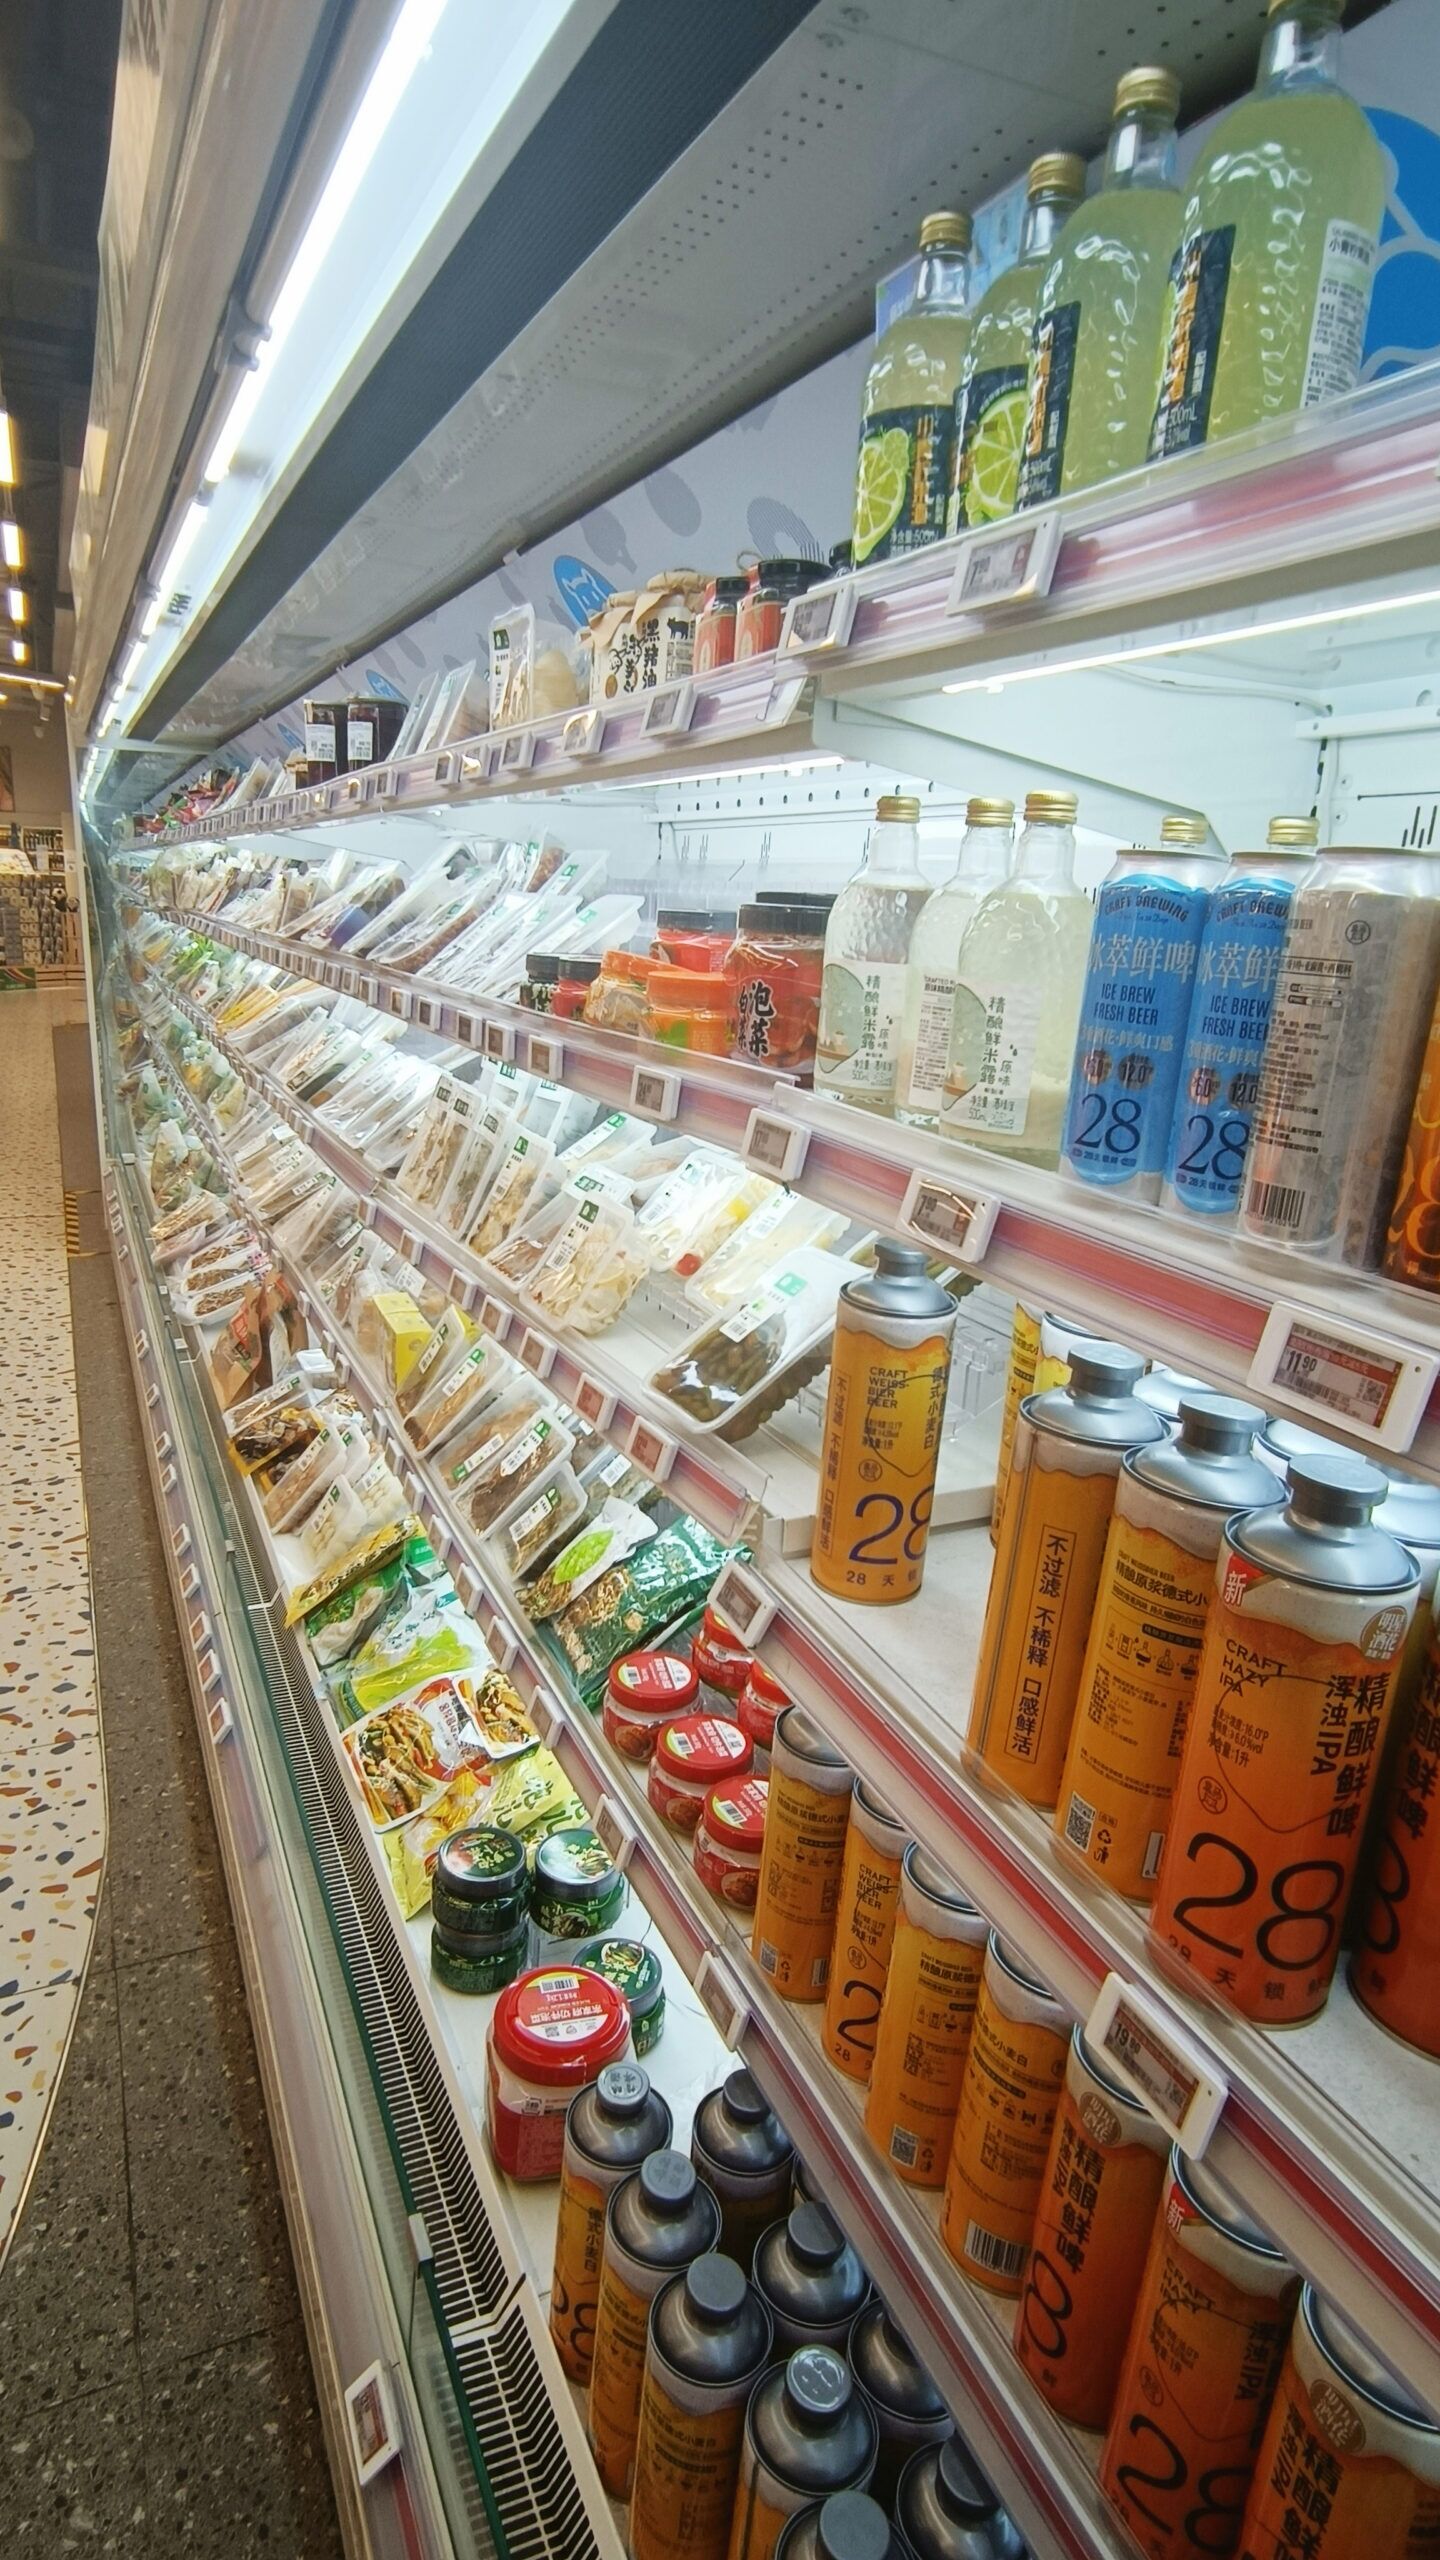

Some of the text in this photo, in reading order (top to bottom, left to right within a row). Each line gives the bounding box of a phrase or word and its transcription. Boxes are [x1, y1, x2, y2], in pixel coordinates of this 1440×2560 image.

[1088, 932, 1197, 985] 冰萃鲜啤
[1101, 982, 1157, 1005] ICE BREW
[1210, 995, 1270, 1018] ICE BREW
[749, 981, 775, 1058] 泡菜
[1092, 1001, 1159, 1026] FRESH BEER
[1201, 1015, 1234, 1037] FRESH
[979, 996, 1006, 1085] 精酿鲜米露
[1074, 1092, 1142, 1154] 28
[1178, 1114, 1250, 1180] 28
[869, 1366, 909, 1379] CRAFT
[866, 1396, 898, 1409] BEER
[867, 1386, 895, 1399] BIER
[848, 1484, 935, 1565] 28
[846, 1570, 867, 1586] 28
[882, 1574, 895, 1587] 天
[1223, 1570, 1247, 1608] 新
[1011, 1533, 1069, 1757] 不过滤 不稀释 口感鲜活
[1225, 1637, 1287, 1677] CRAFT
[1219, 1671, 1244, 1698] IPA
[1222, 1655, 1270, 1688] HAZY
[1310, 1673, 1357, 1776] 浑浊IPA
[1326, 1671, 1391, 1837] 精酿鲜啤
[859, 1862, 891, 1886] CRAFT
[1172, 1832, 1345, 1972] 28
[1215, 1967, 1237, 1991] 天
[834, 2042, 851, 2062] 28
[1167, 2199, 1185, 2233] 新
